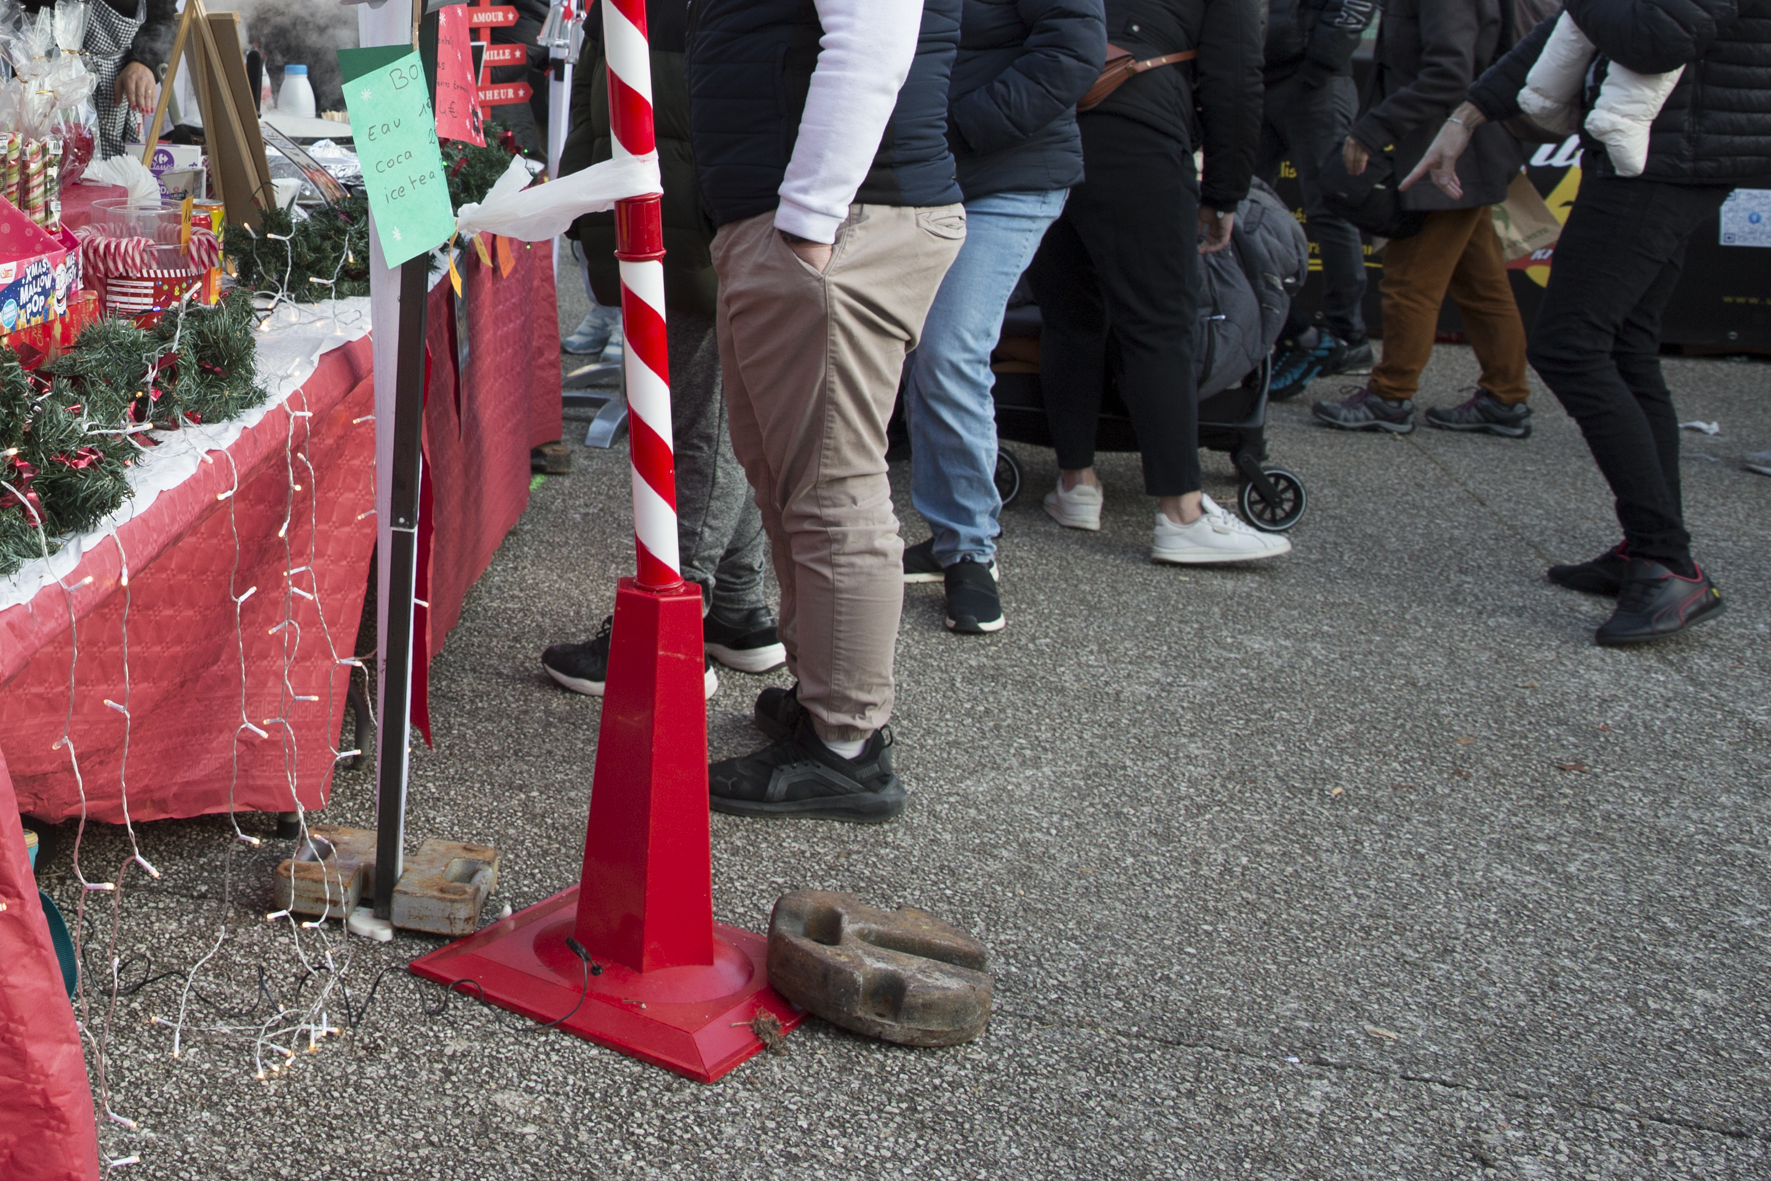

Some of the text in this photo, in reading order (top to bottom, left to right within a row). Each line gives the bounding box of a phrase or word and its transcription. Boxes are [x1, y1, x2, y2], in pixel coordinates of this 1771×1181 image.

[472, 11, 504, 22] AMOUR
[478, 88, 514, 101] NHEUR
[368, 119, 401, 142] Eau
[384, 187, 406, 205] ice
[20, 273, 53, 305] MALLOW
[26, 294, 45, 320] POP
